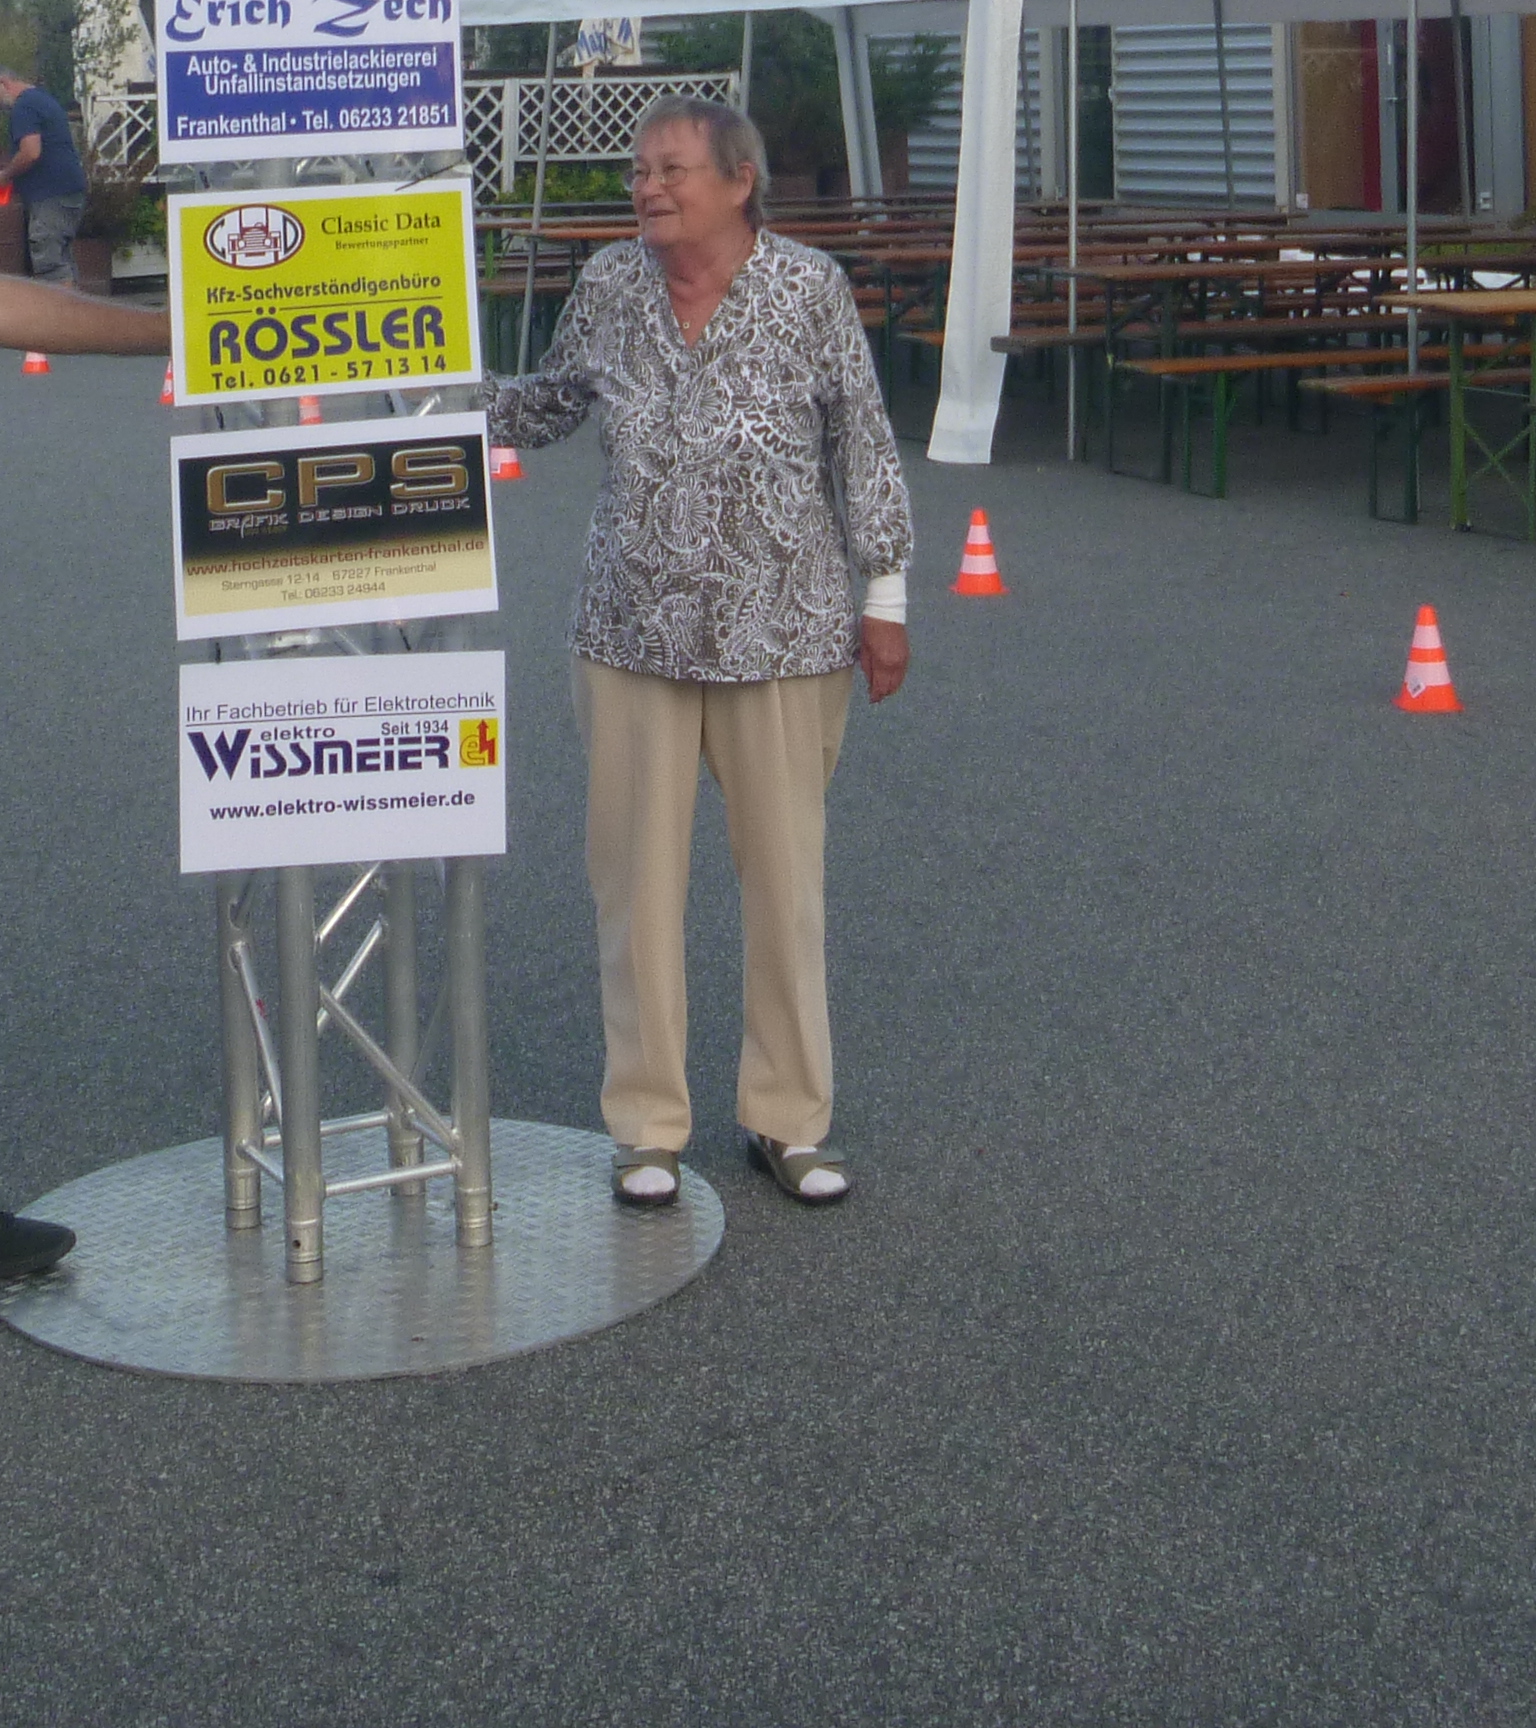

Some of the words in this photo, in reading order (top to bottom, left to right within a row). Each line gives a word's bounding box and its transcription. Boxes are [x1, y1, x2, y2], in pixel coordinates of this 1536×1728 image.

[187, 55, 237, 76] Auto-
[244, 53, 256, 73] &
[263, 47, 437, 72] Industrielackiererei
[205, 70, 420, 95] Unfallinstandsetzungen
[177, 112, 285, 137] Frankenthal
[302, 110, 332, 131] Tel.
[339, 107, 391, 129] 06233
[398, 105, 449, 125] 21851
[321, 215, 389, 235] Classic
[396, 212, 441, 232] Data
[335, 236, 429, 251] Bewertungspartner
[207, 274, 441, 304] Kfz-Sachverständigenbüro
[209, 305, 445, 366] RÖSSLER
[212, 371, 254, 390] Tel.
[264, 364, 319, 385] 0621
[347, 360, 373, 379] 57
[386, 358, 410, 376] 13
[422, 355, 446, 372] 14
[206, 446, 468, 516] CPS
[298, 505, 382, 523] DESIGN
[391, 496, 471, 515] DRUCK
[187, 539, 484, 576] www.hochzeitskarten-frankenthal.de
[374, 562, 437, 578] Frankenthal
[186, 706, 210, 722] Ihr
[217, 699, 327, 720] Fachbetrieb
[334, 698, 358, 714] für
[364, 692, 495, 713] Elektrotechnik
[260, 726, 335, 742] elektro
[381, 721, 410, 736] Seit
[415, 720, 449, 735] 1934
[210, 791, 475, 821] www.elektro-wissmeier.de
